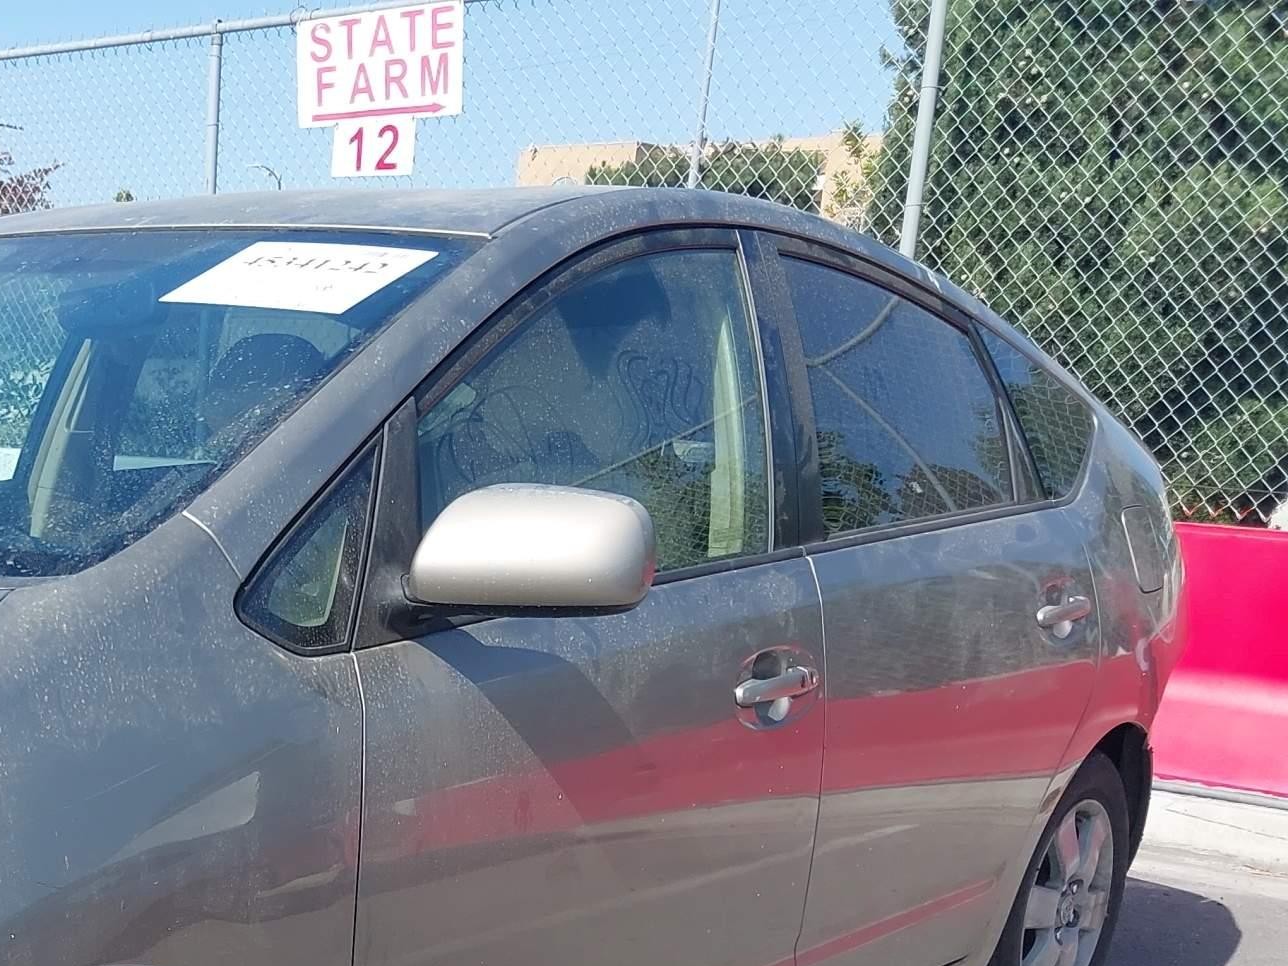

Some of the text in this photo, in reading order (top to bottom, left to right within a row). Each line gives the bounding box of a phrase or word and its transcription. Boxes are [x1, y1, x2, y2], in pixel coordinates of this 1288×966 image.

[310, 5, 455, 63] STATE
[316, 52, 449, 107] FARM
[348, 124, 400, 172] 12
